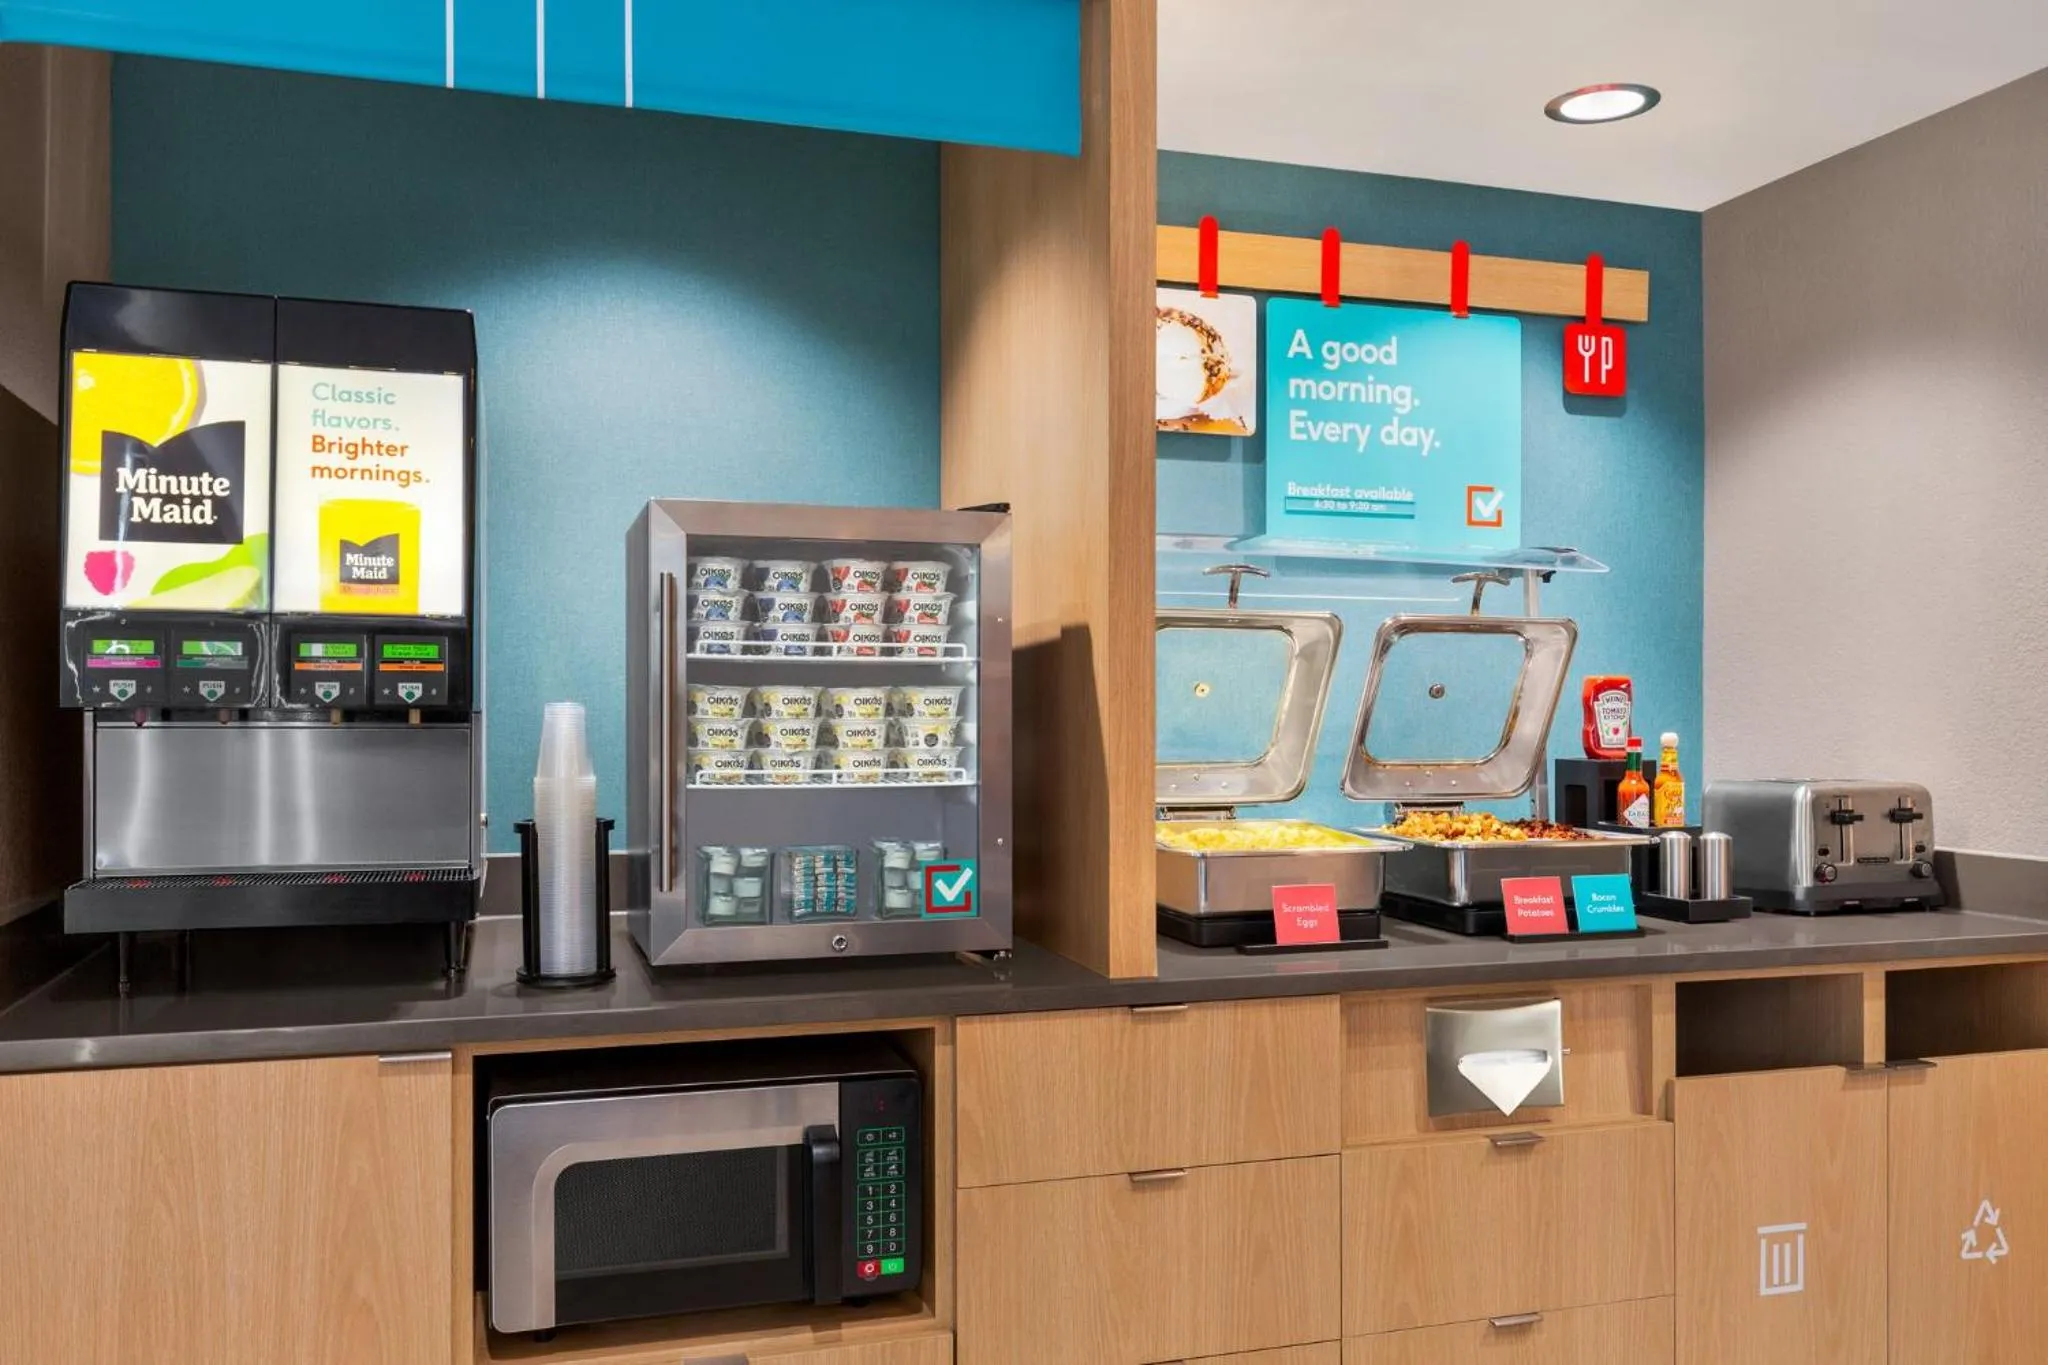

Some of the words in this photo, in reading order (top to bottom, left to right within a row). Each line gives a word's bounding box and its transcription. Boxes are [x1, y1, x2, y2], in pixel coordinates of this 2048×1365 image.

[1287, 329, 1313, 359] A
[1321, 335, 1398, 370] good
[312, 382, 397, 405] Classic
[1289, 375, 1420, 414] morning.
[311, 408, 400, 431] flavors.
[1289, 409, 1372, 453] Every
[1380, 416, 1441, 457] day.
[311, 434, 409, 461] Brighter
[116, 467, 231, 497] Minute
[311, 463, 431, 489] mornings.
[1288, 481, 1350, 498] Breakfast
[1354, 486, 1414, 500] available
[345, 552, 395, 568] Minute
[352, 566, 388, 580] Maid
[1513, 895, 1554, 905] Breakfast
[1281, 902, 1330, 913] Scrambled
[1518, 908, 1554, 918] Potatoes
[1587, 904, 1625, 914] Crumbles
[1296, 916, 1318, 929] Eggs
[868, 1186, 873, 1196] 1
[890, 1184, 896, 1194] 2
[866, 1200, 873, 1211] 3
[889, 1199, 896, 1208] 4
[866, 1215, 873, 1225] 5
[889, 1213, 896, 1222] 6
[867, 1229, 873, 1239] 7
[889, 1227, 896, 1237] 8
[866, 1244, 873, 1254] 9
[889, 1242, 896, 1251] 0
